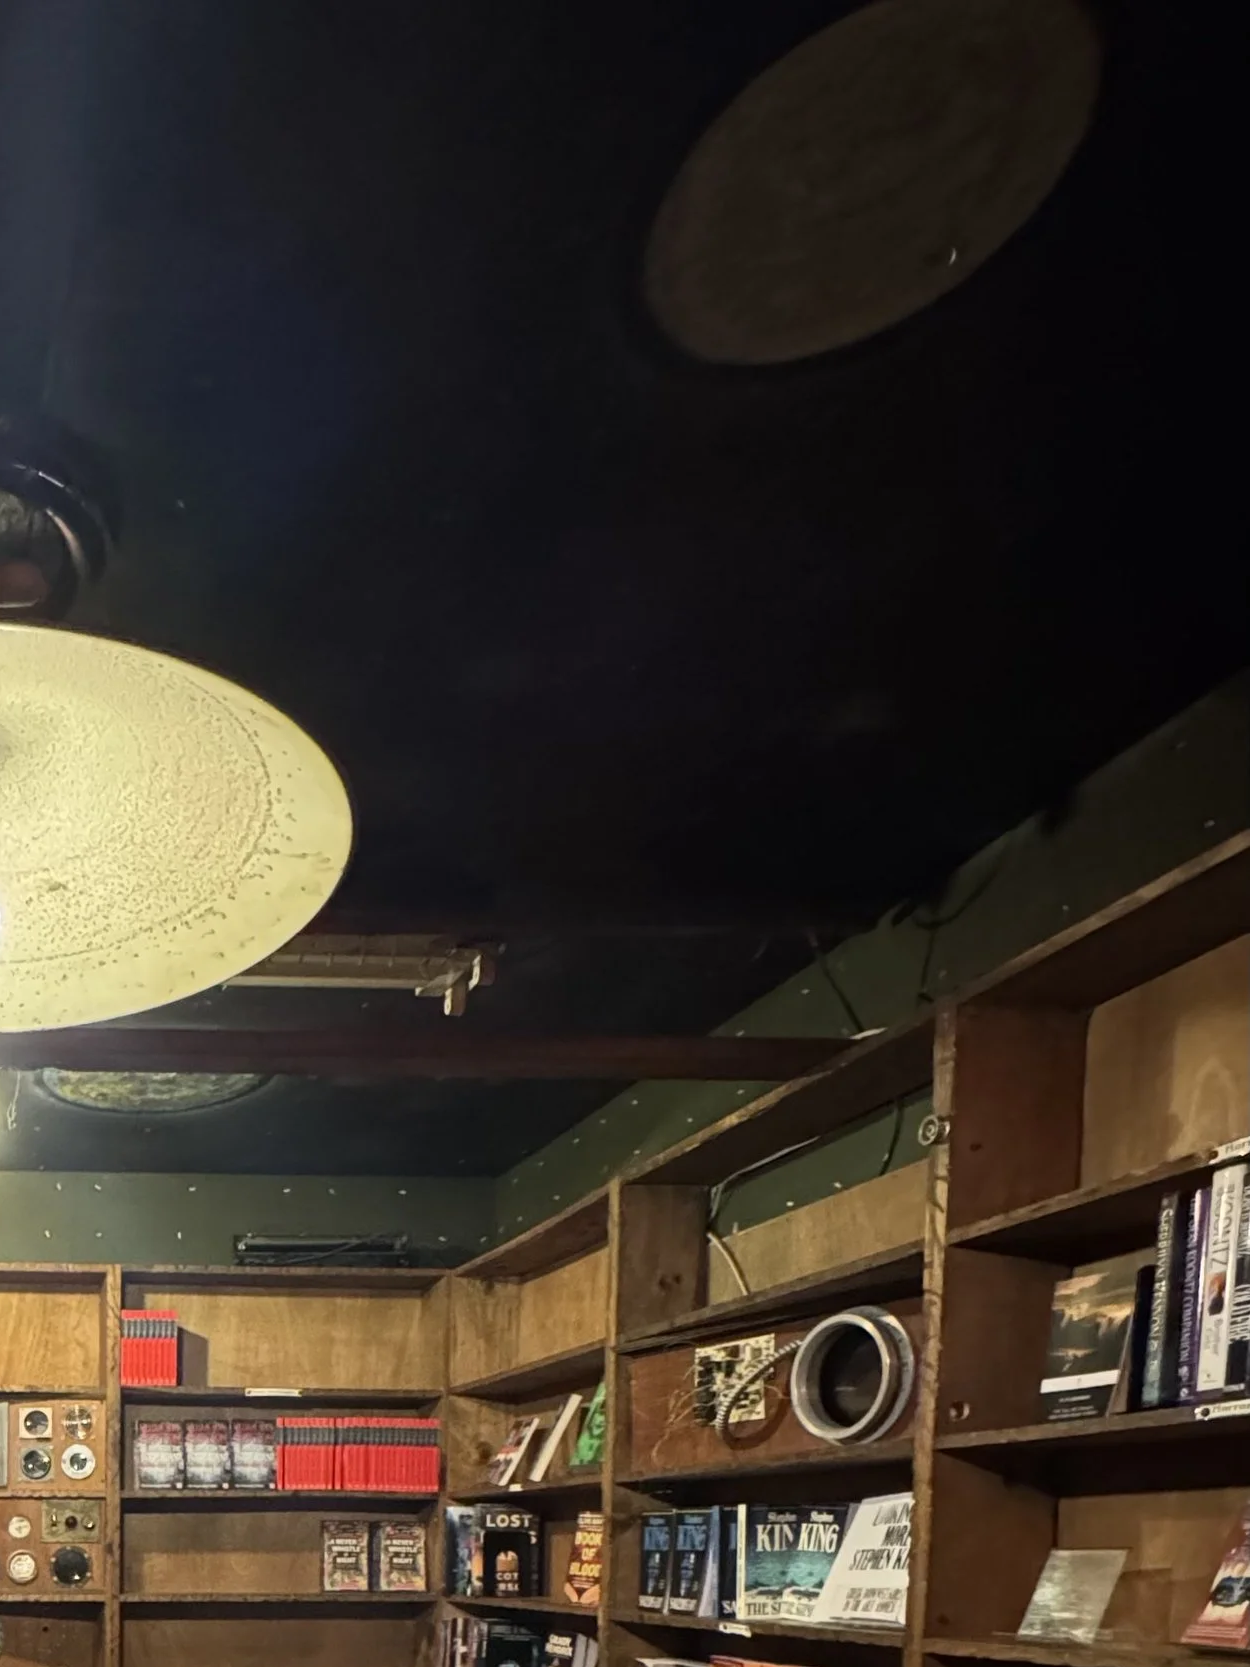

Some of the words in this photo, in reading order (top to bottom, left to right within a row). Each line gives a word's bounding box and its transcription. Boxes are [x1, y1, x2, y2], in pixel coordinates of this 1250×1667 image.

[485, 1513, 533, 1528] LOST
[643, 1526, 670, 1551] KING
[676, 1524, 708, 1551] KING
[755, 1523, 797, 1552] KIN
[797, 1523, 840, 1553] KING
[848, 1550, 892, 1571] STEPHEN
[895, 1546, 910, 1570] KI
[496, 1572, 519, 1581] COT
